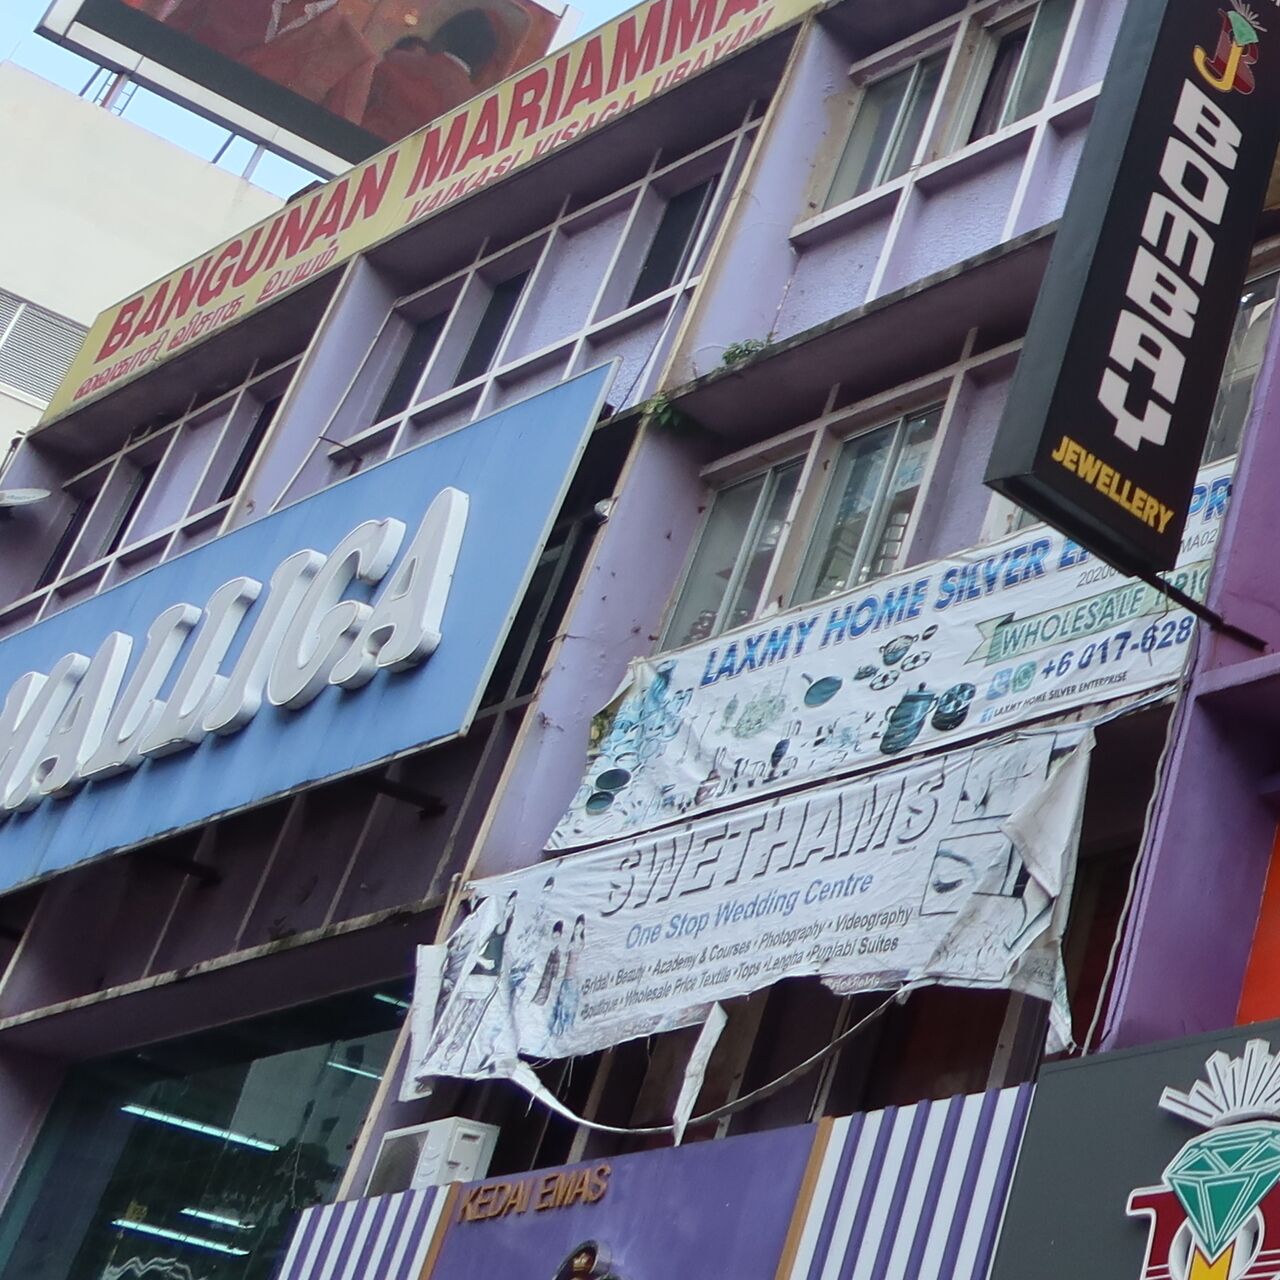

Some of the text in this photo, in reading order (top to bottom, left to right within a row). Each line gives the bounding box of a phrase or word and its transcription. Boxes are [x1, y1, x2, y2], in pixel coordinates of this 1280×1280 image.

[94, 149, 399, 365] BANGUNAN
[1096, 78, 1242, 451] BOMBAY
[1051, 436, 1175, 534] JEWELLERY
[699, 615, 820, 689] LAXMY
[819, 575, 932, 650] HOME
[932, 536, 1054, 612] SILVER
[1000, 587, 1146, 657] WHOLESALE
[1048, 684, 1077, 700] SILVER
[1078, 671, 1128, 693] ENTERPRISE
[600, 757, 947, 917] SWETHAMS
[626, 872, 874, 950] One Stop Wedding Centre
[651, 951, 700, 977] Academy
[708, 939, 751, 961] Courses
[761, 922, 825, 952] Photography
[836, 904, 914, 934] Videography
[624, 984, 672, 1008] Wholesale
[672, 974, 699, 996] Price
[700, 968, 731, 987] Textile
[737, 958, 760, 982] Tops
[858, 934, 900, 955] Suites
[459, 1163, 612, 1224] KEDAI EMAS
